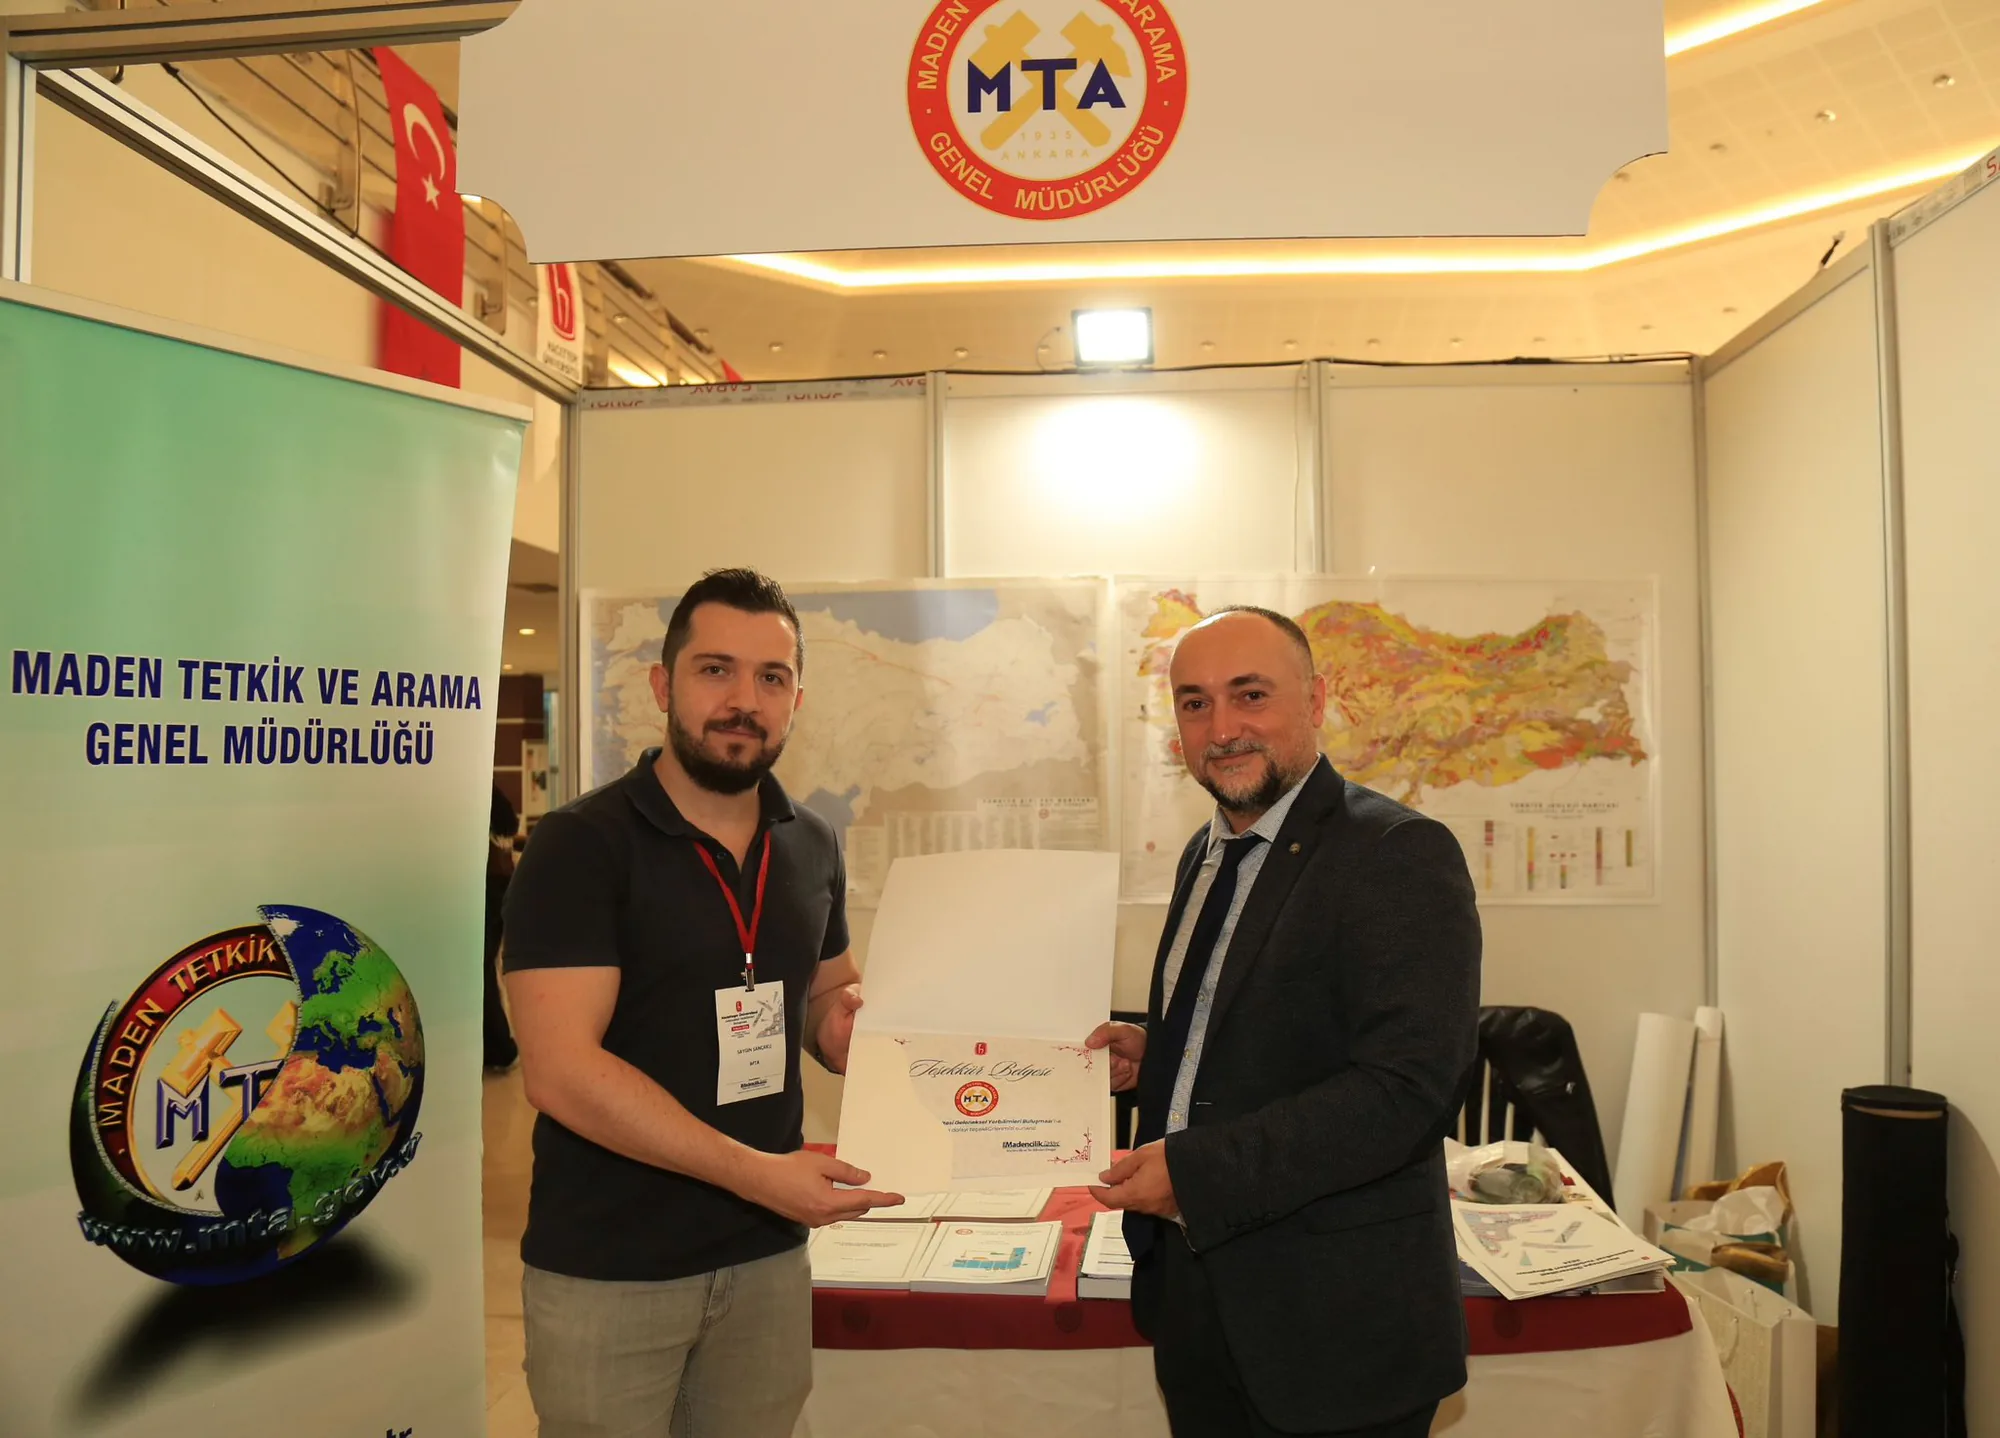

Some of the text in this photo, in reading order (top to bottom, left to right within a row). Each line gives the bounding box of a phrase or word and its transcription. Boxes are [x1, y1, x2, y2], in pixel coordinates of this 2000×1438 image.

[917, 0, 970, 90] MADEN
[967, 58, 1127, 113] MTA
[1001, 149, 1091, 161] ANKARA
[1020, 130, 1073, 141] 1935
[929, 125, 1165, 212] GENEL MÜDÜRLÜĞÜ
[12, 650, 482, 710] MADEN TETKİK VE ARAMA
[85, 716, 435, 766] GENEL MÜDÜRLÜĞÜ
[97, 933, 279, 1127] MADEN TETKİK
[909, 1059, 1055, 1082] Teşekkür Belgesi
[963, 1094, 989, 1103] MTA
[1006, 1140, 1043, 1148] Madencilik
